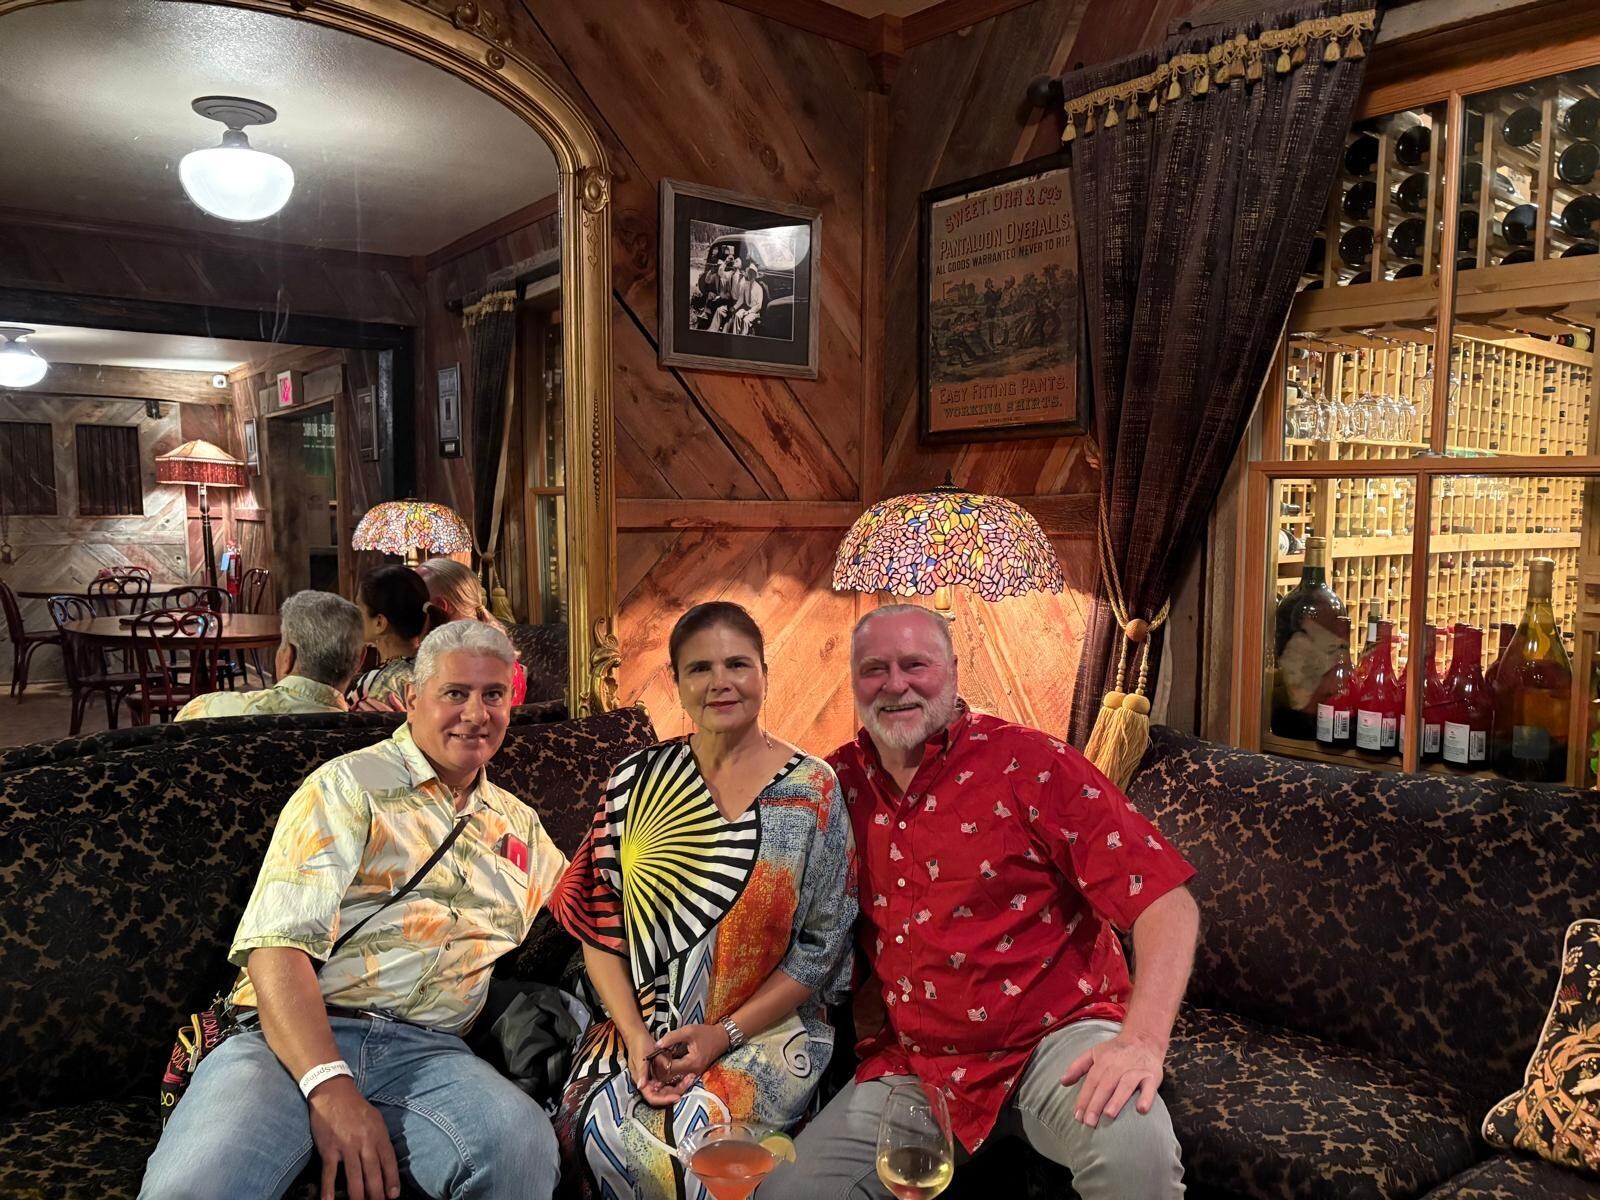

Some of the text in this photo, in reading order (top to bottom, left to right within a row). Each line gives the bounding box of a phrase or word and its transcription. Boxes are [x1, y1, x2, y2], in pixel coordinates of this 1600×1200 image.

[993, 188, 1023, 212] ORR
[1025, 187, 1035, 206] &
[935, 264, 946, 276] ALL
[947, 258, 970, 273] GOODS
[972, 247, 1016, 267] WARRANTED
[1018, 242, 1043, 257] NEVER
[1044, 238, 1055, 250] TO
[940, 228, 1002, 261] PANTALOON
[939, 387, 969, 404] EASY
[972, 382, 1016, 400] FITTING
[943, 402, 1002, 419] WORKING
